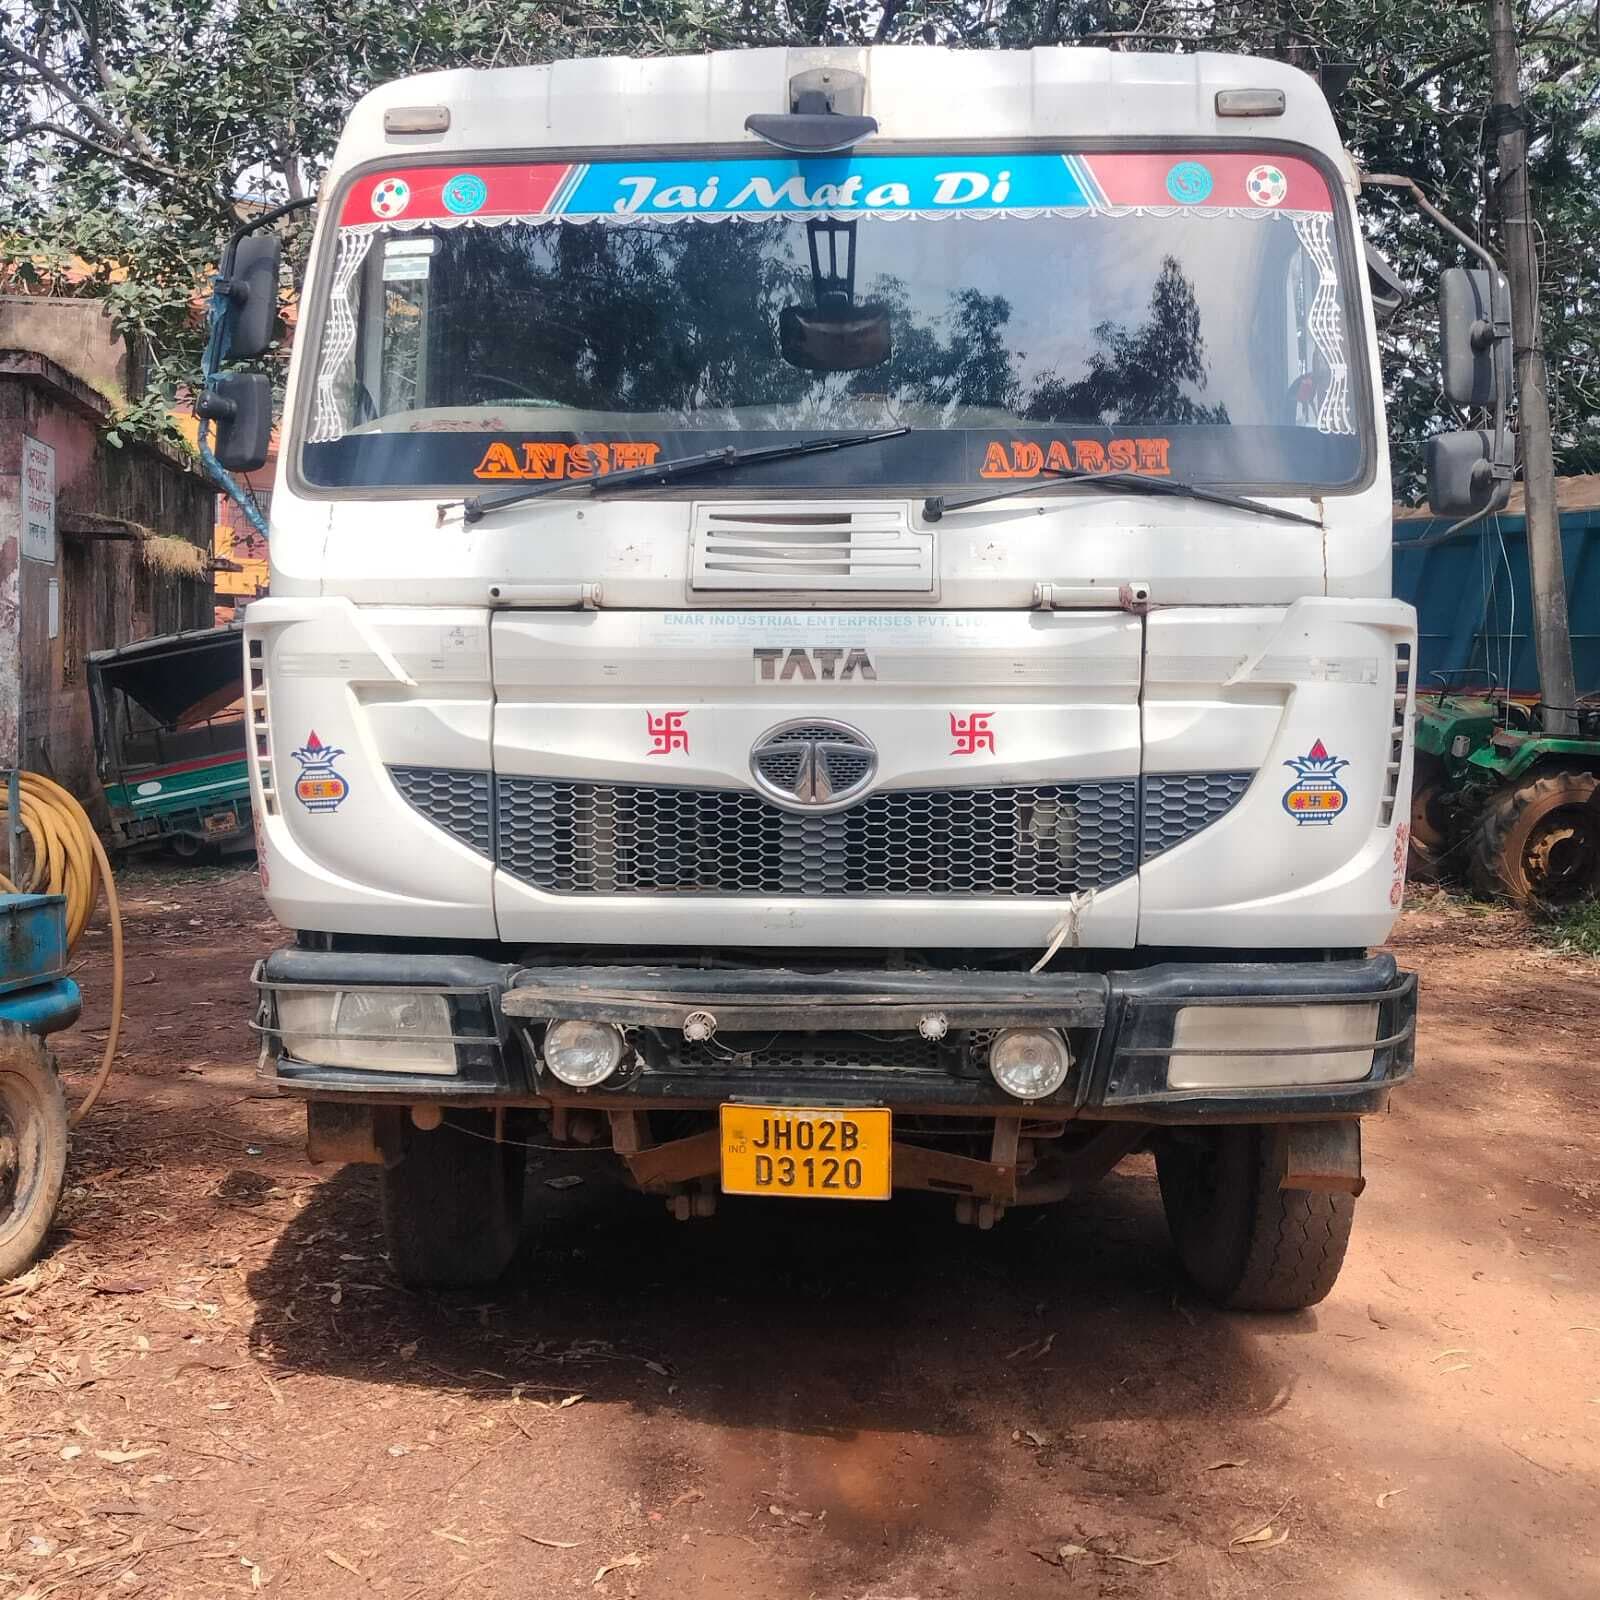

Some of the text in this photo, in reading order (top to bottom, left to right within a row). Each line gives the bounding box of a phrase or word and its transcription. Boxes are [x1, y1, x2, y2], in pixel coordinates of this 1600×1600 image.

[613, 171, 1011, 214] Jai Mata Di
[473, 442, 661, 480] ANSH
[979, 438, 1171, 479] ADARSH
[663, 614, 705, 625] ENAR
[709, 614, 801, 626] INDUSTRIAL
[806, 615, 913, 626] ENTERPRISES
[917, 615, 951, 627] PVT.
[753, 648, 877, 680] TATA
[752, 1119, 859, 1151] JH02B
[755, 1155, 862, 1189] D3120
